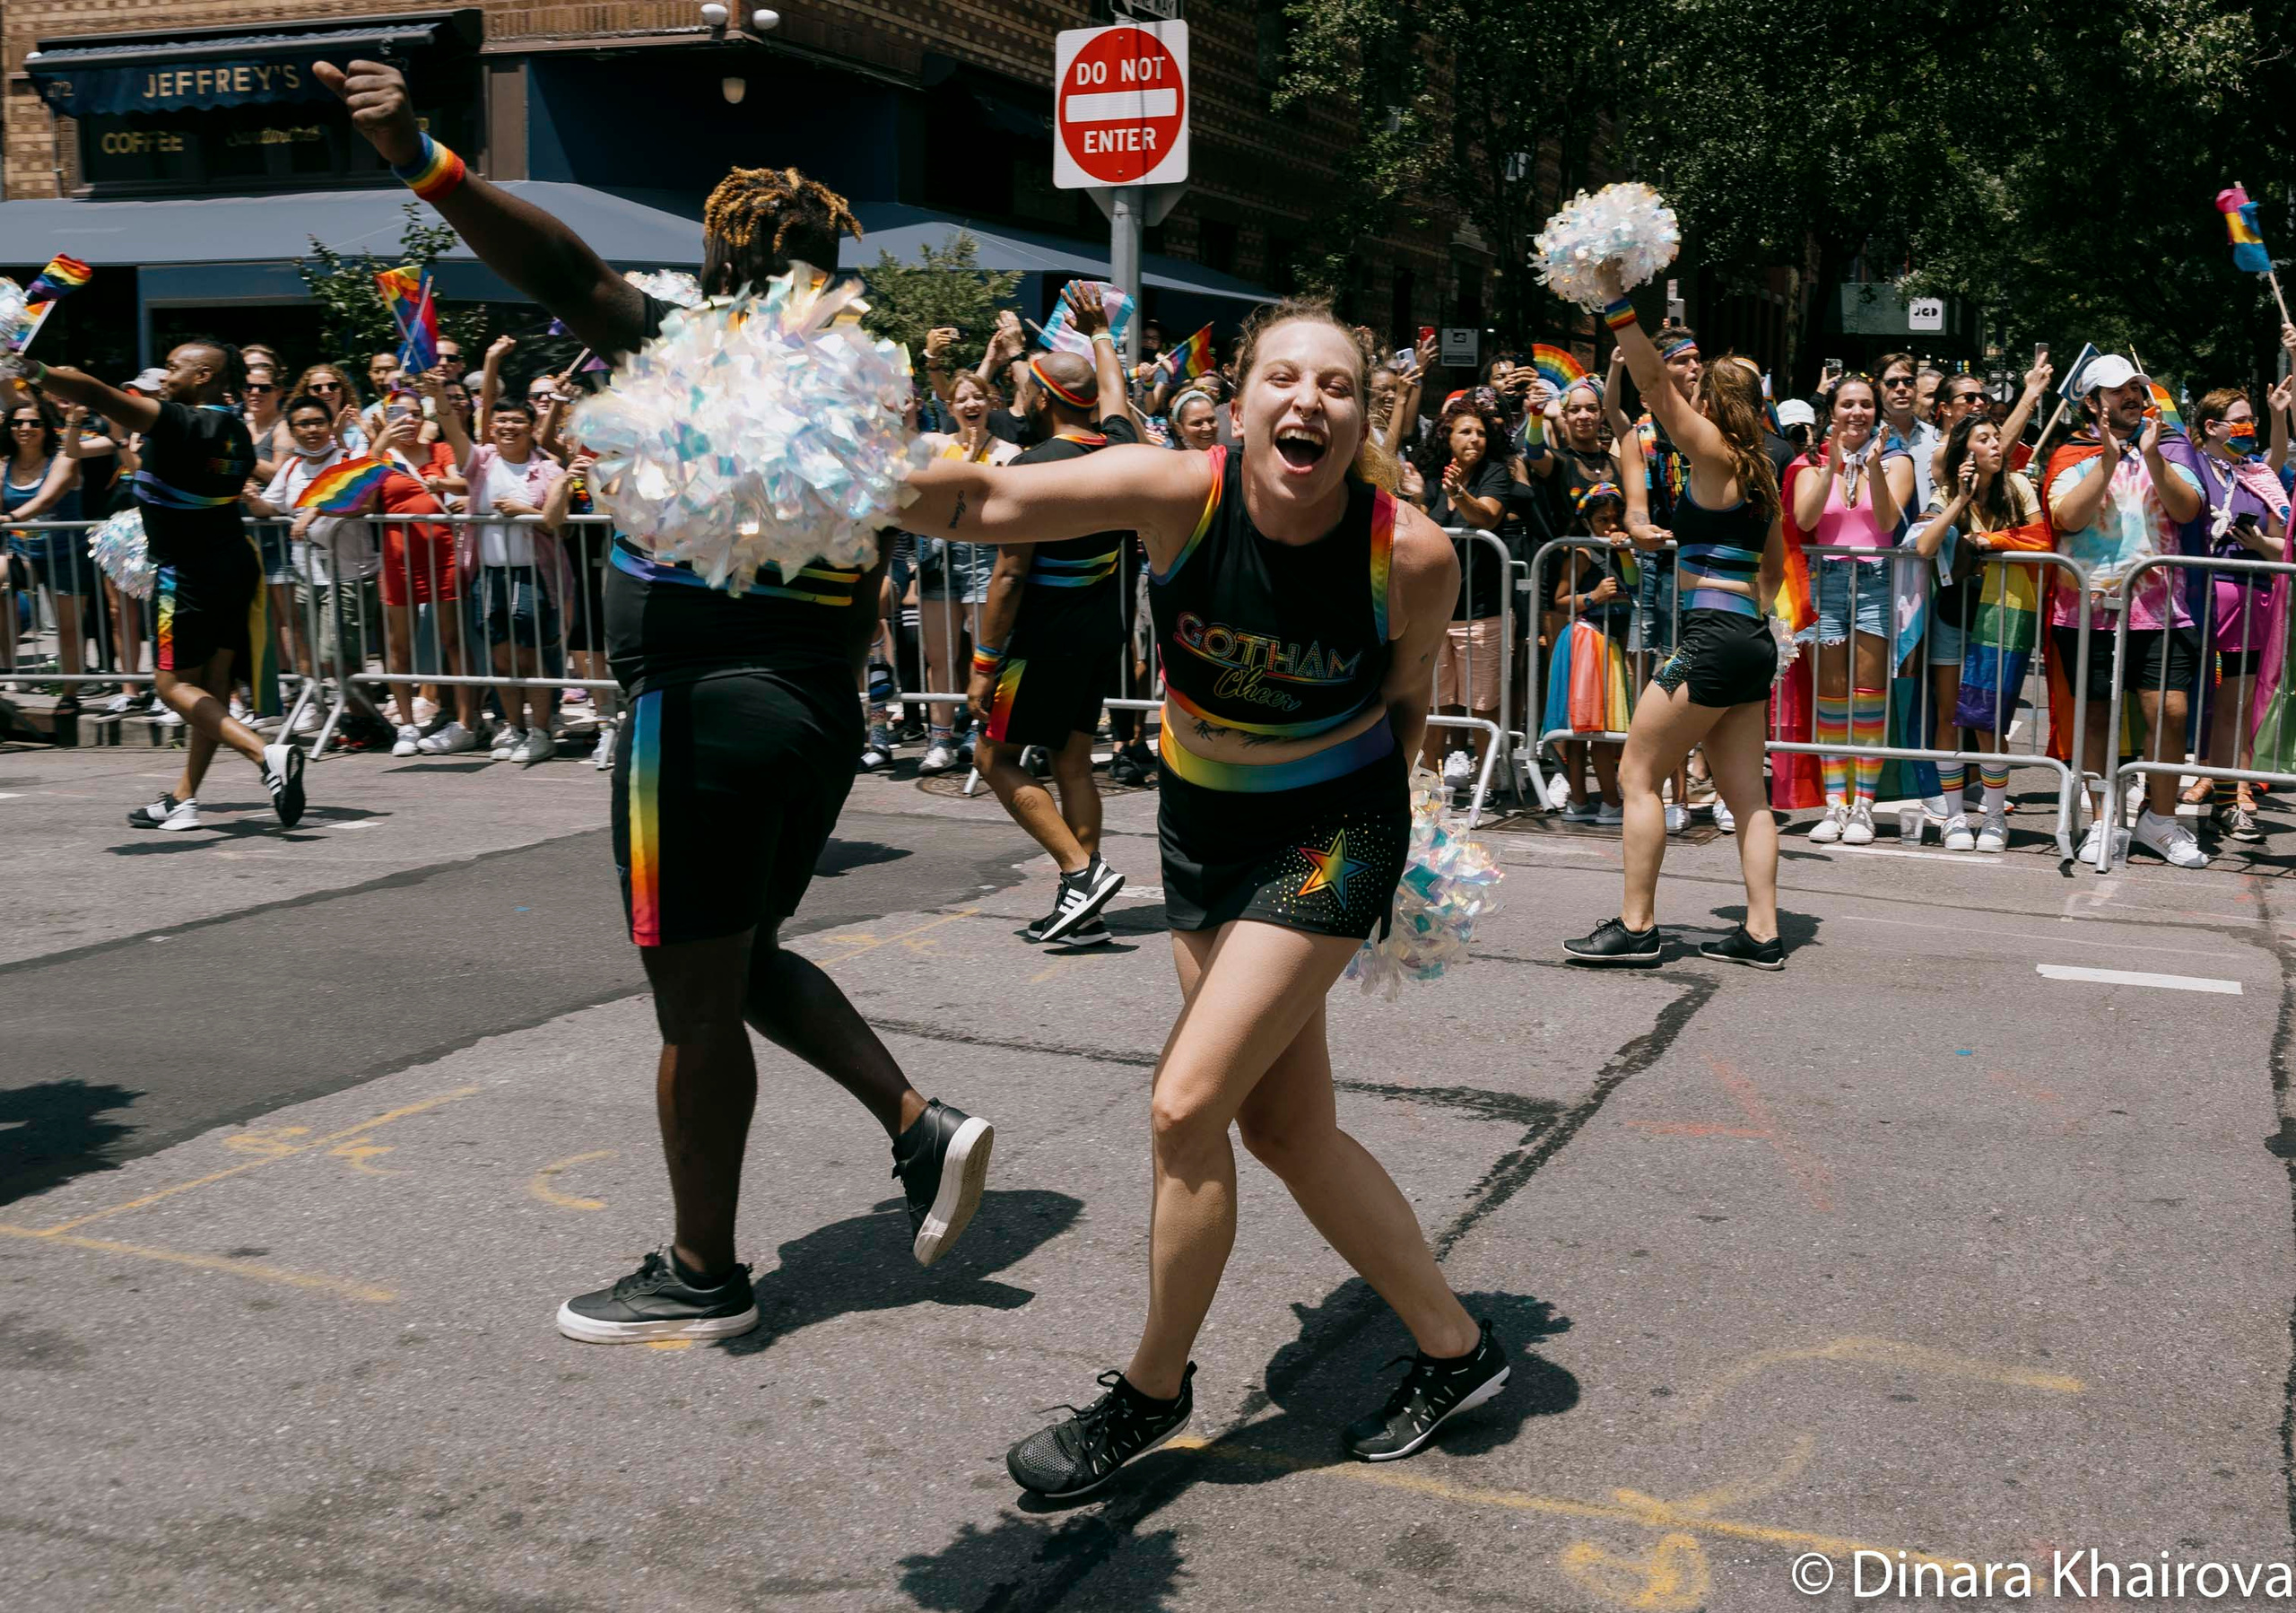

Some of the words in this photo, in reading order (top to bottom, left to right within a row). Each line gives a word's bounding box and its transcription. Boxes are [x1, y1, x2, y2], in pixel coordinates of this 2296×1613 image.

[143, 64, 300, 99] JEFFREY'S
[1076, 61, 1107, 85] DO
[1121, 57, 1166, 83] NOT
[101, 131, 185, 155] COFFEE
[1083, 127, 1156, 153] ENTER
[1176, 611, 1363, 680] GOTHAM
[1213, 664, 1301, 711] Cheer
